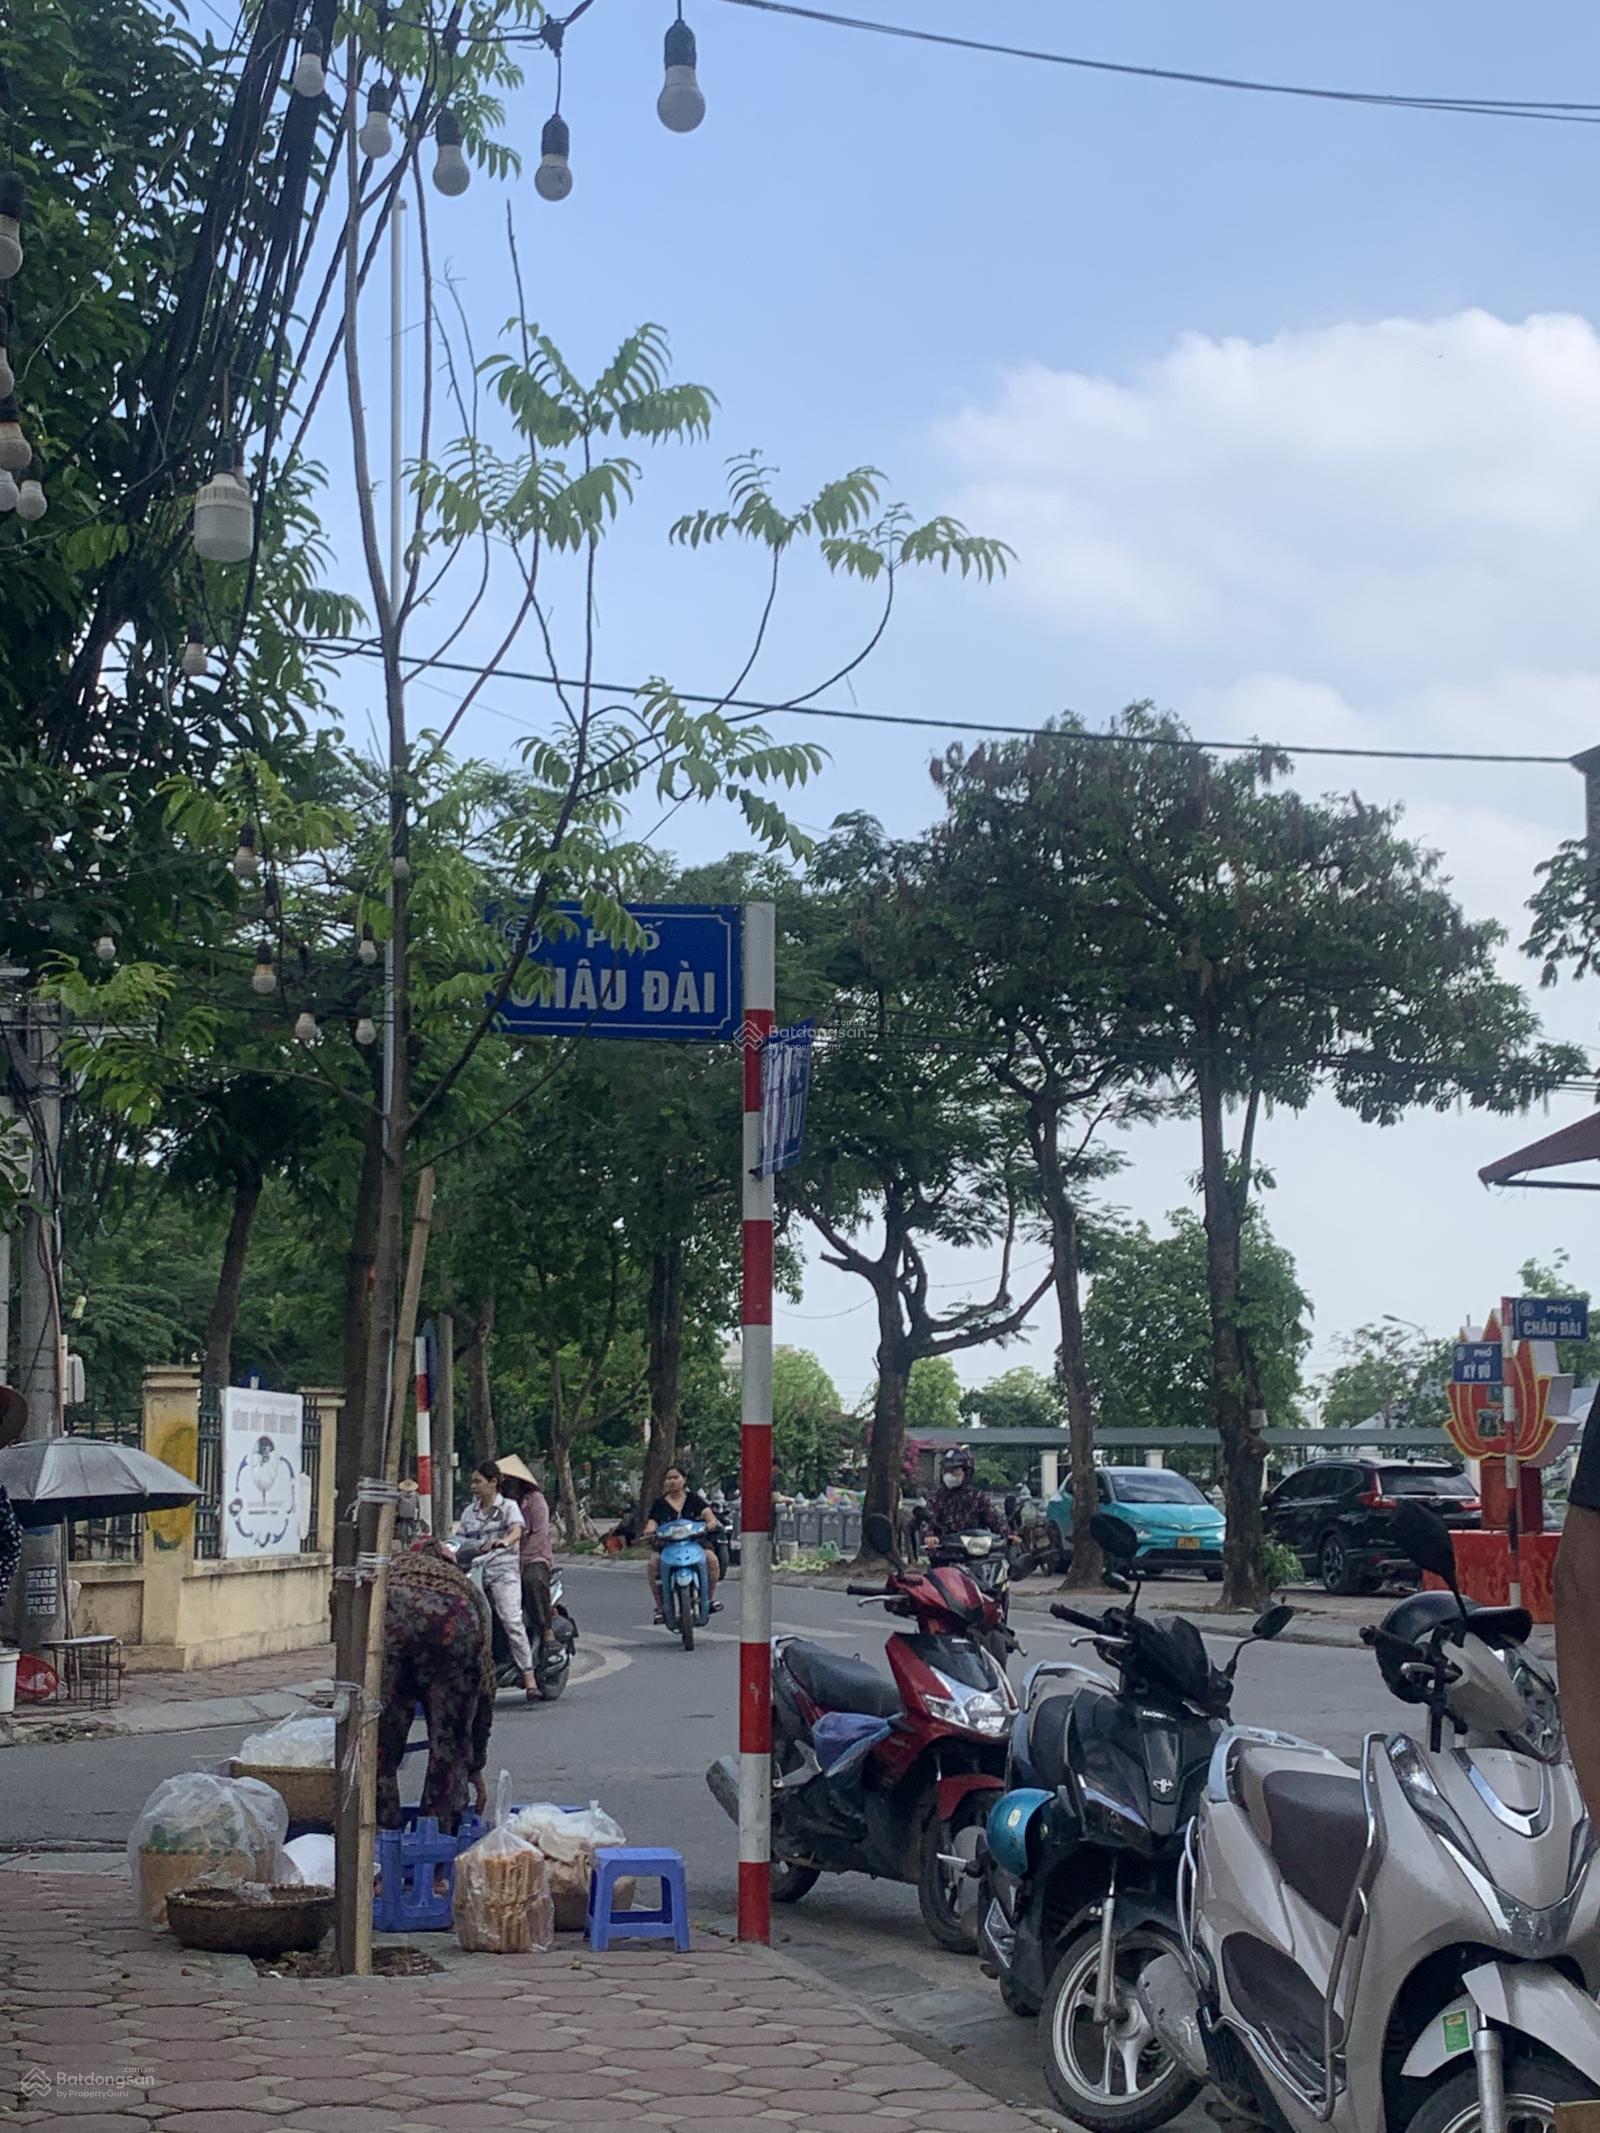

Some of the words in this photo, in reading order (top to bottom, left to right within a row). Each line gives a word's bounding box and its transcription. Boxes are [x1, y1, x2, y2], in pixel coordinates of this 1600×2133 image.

[642, 960, 716, 1013] ĐÀI
[1547, 1303, 1572, 1315] PHỐ
[1523, 1318, 1557, 1337] CHÂU
